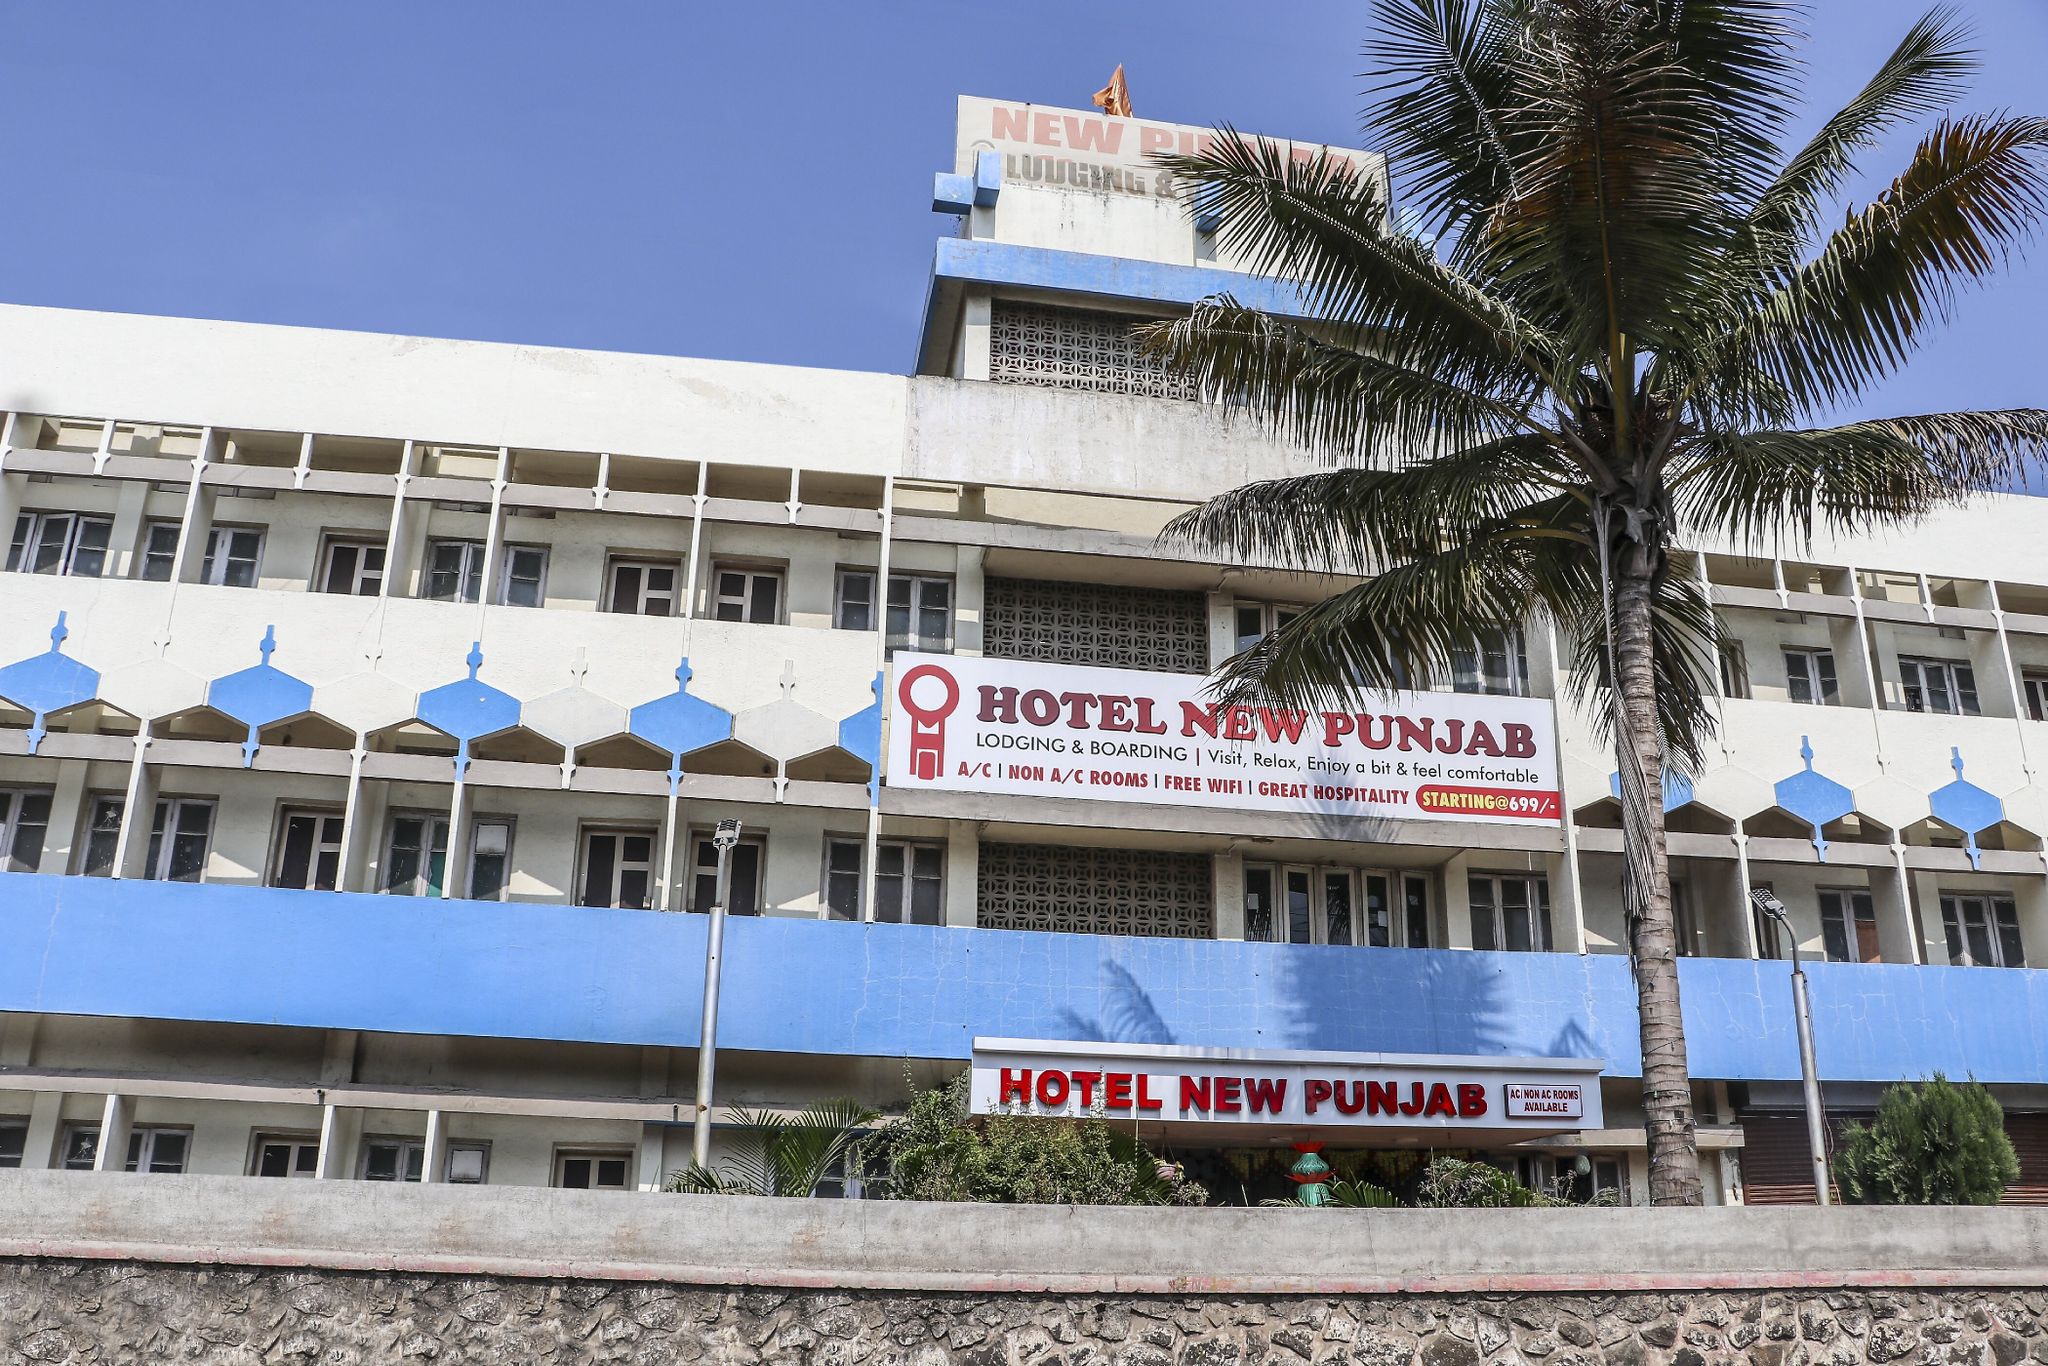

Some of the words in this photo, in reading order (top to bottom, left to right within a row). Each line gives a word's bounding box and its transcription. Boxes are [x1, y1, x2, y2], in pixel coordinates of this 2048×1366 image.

[992, 107, 1125, 155] NEW
[1140, 126, 1358, 196] PUAB
[1154, 170, 1178, 200] &
[976, 685, 1168, 736] HOTEL
[1179, 700, 1309, 745] NEW
[1321, 711, 1537, 759] PUNJAB
[976, 732, 1066, 753] LODGING
[1072, 740, 1084, 755] &
[1090, 741, 1188, 762] BOARDING
[1208, 749, 1248, 768] Visit,
[1254, 752, 1302, 772] Relax,
[1307, 756, 1350, 776] Enjoy
[1355, 764, 1365, 775] a
[1371, 759, 1391, 775] bit
[1396, 761, 1408, 777] &
[1413, 762, 1441, 778] feel
[1448, 765, 1539, 783] comfortable
[958, 761, 991, 779] A/C
[1008, 765, 1044, 782] NON
[1050, 767, 1083, 785] A/C
[1090, 770, 1148, 788] ROOMS
[1164, 775, 1202, 792] FREE
[1207, 778, 1243, 795] WIFI
[1258, 781, 1307, 799] GREAT
[1313, 786, 1410, 805] HOSPITALITY
[1000, 1067, 1163, 1110] HOTEL
[1179, 1075, 1288, 1114] NEW
[1304, 1078, 1489, 1117] PUNJAB
[1524, 1089, 1539, 1099] NON
[1541, 1090, 1551, 1099] AC
[1553, 1090, 1578, 1100] ROOMS
[1524, 1102, 1568, 1112] AVAILABLE
